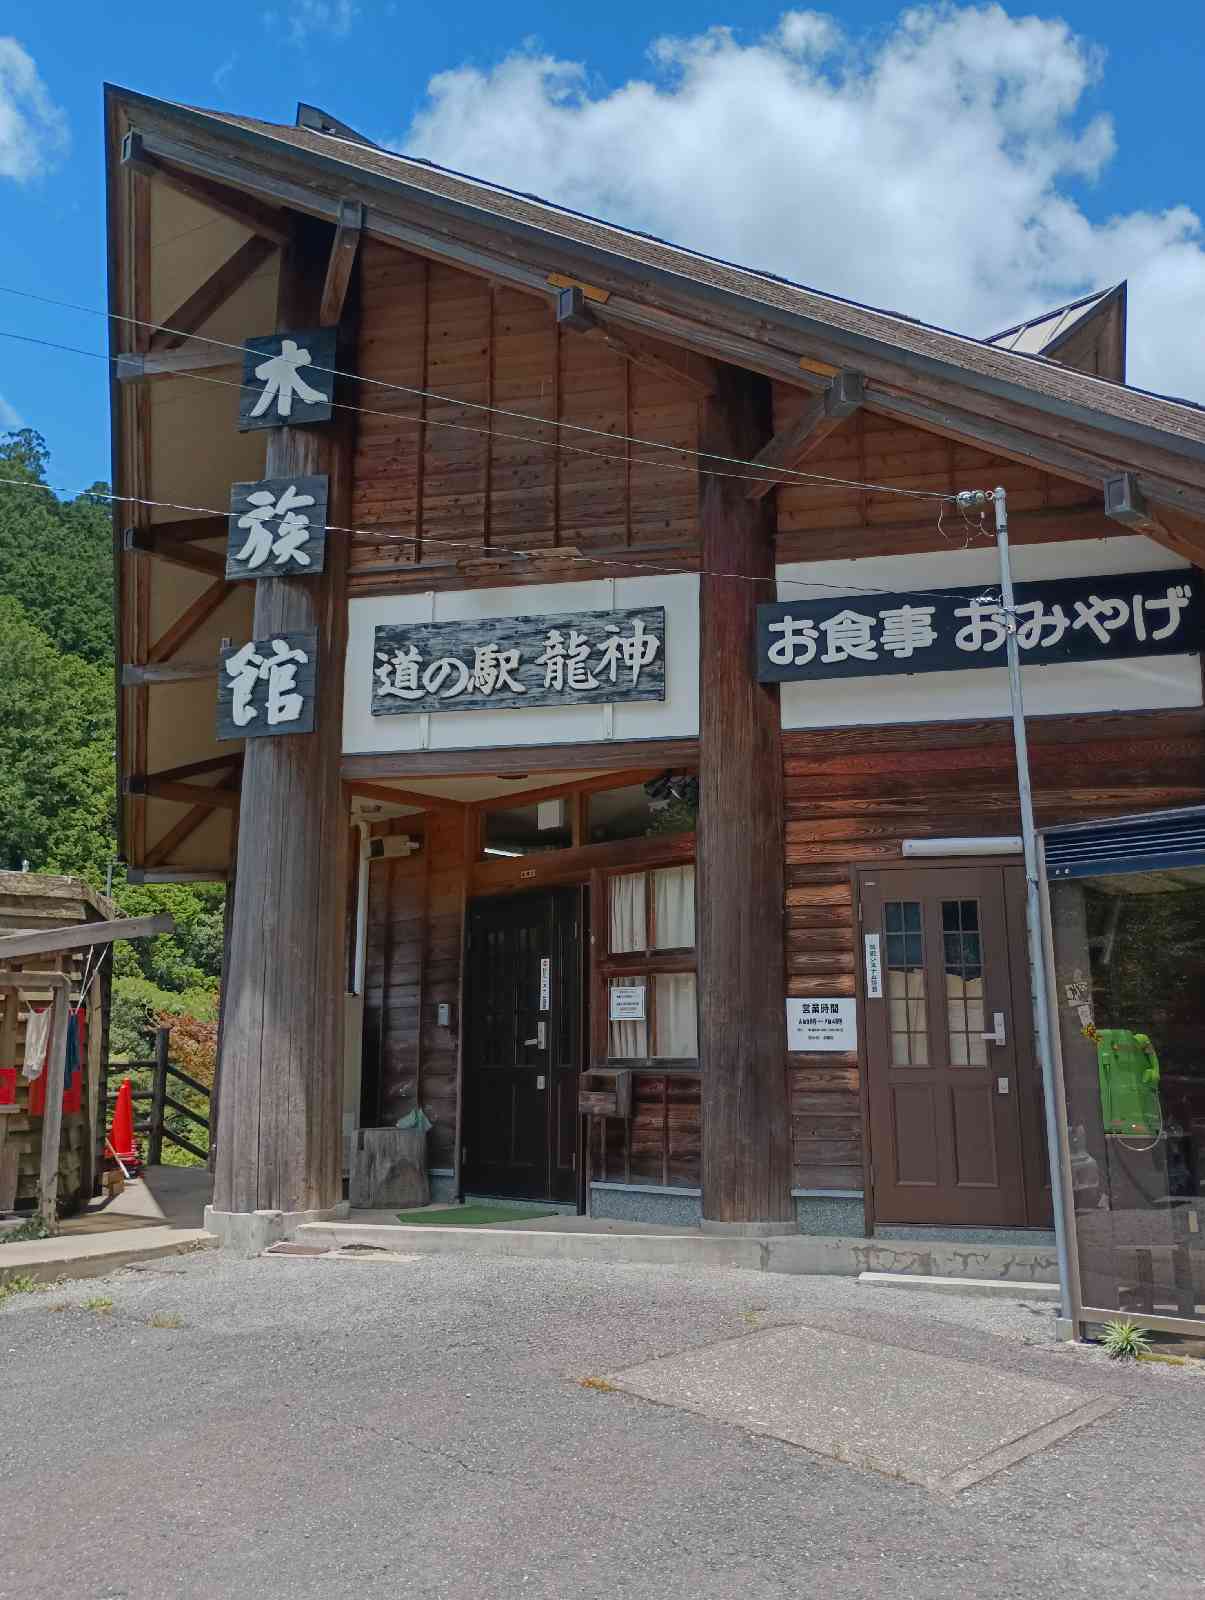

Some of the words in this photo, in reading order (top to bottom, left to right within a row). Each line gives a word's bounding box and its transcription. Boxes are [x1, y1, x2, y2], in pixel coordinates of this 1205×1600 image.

[225, 339, 328, 727] 木族館
[374, 645, 527, 700] 道の駅
[536, 618, 660, 692] 龍神
[767, 604, 938, 666] お食事
[953, 584, 1193, 652] おみやげ
[802, 1003, 839, 1014] 営業時間
